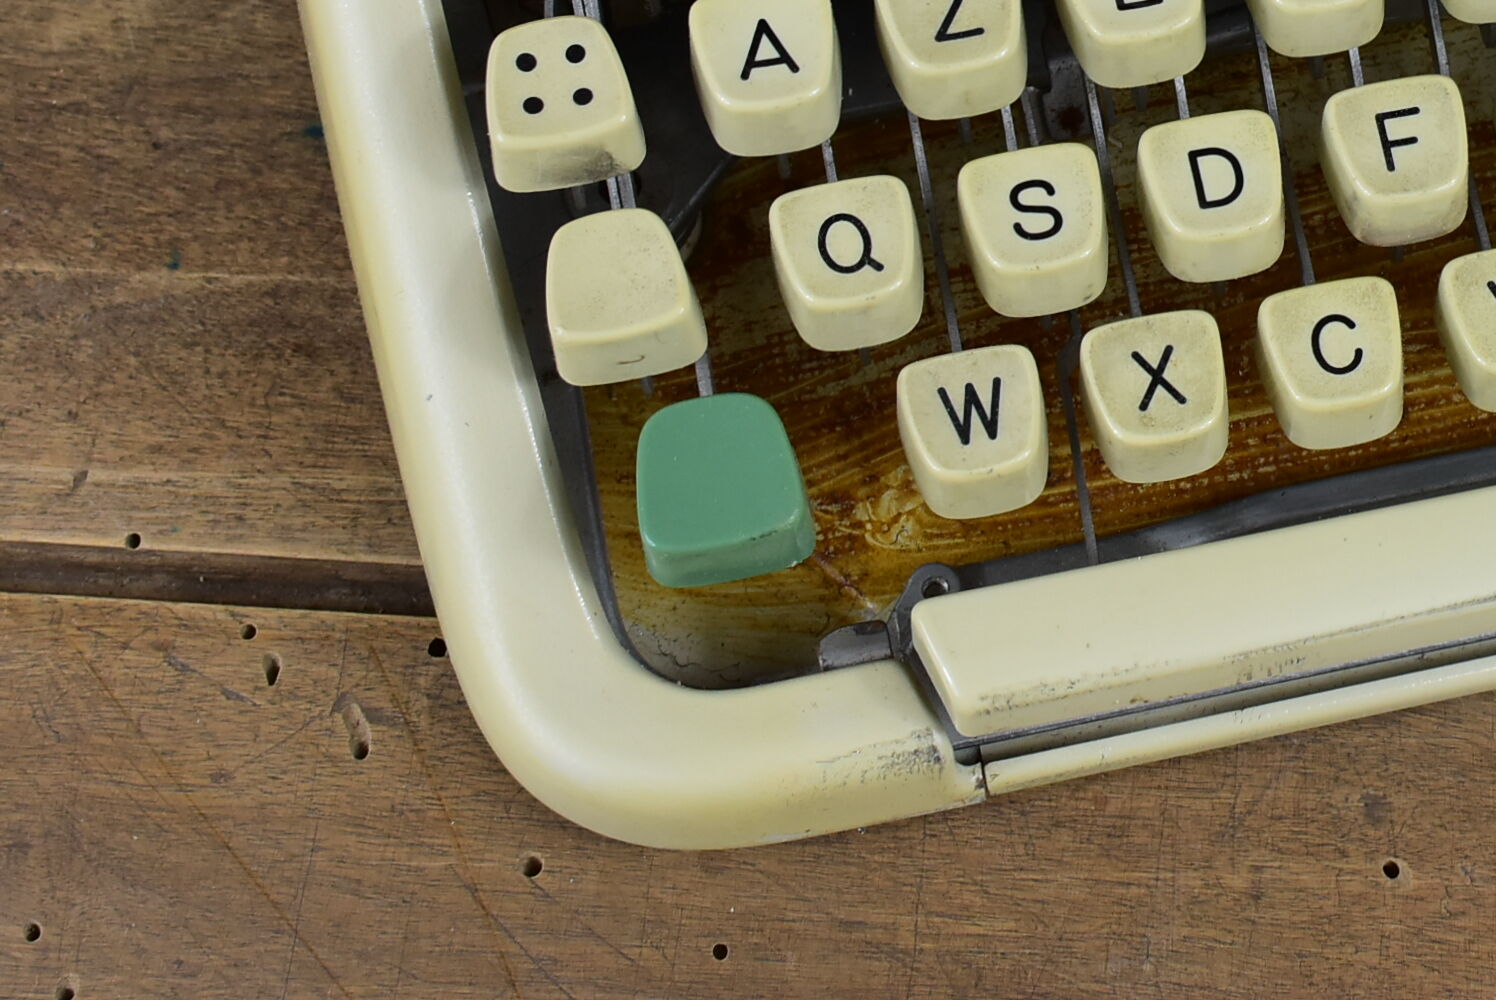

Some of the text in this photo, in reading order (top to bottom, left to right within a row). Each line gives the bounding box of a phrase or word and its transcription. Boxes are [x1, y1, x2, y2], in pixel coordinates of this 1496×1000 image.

[740, 18, 800, 81] A
[1374, 106, 1421, 173] F
[1009, 179, 1064, 241] S
[1187, 147, 1244, 210] D
[817, 212, 885, 274] Q
[1310, 313, 1364, 375] C
[1130, 344, 1187, 412] X
[936, 376, 1002, 446] W
